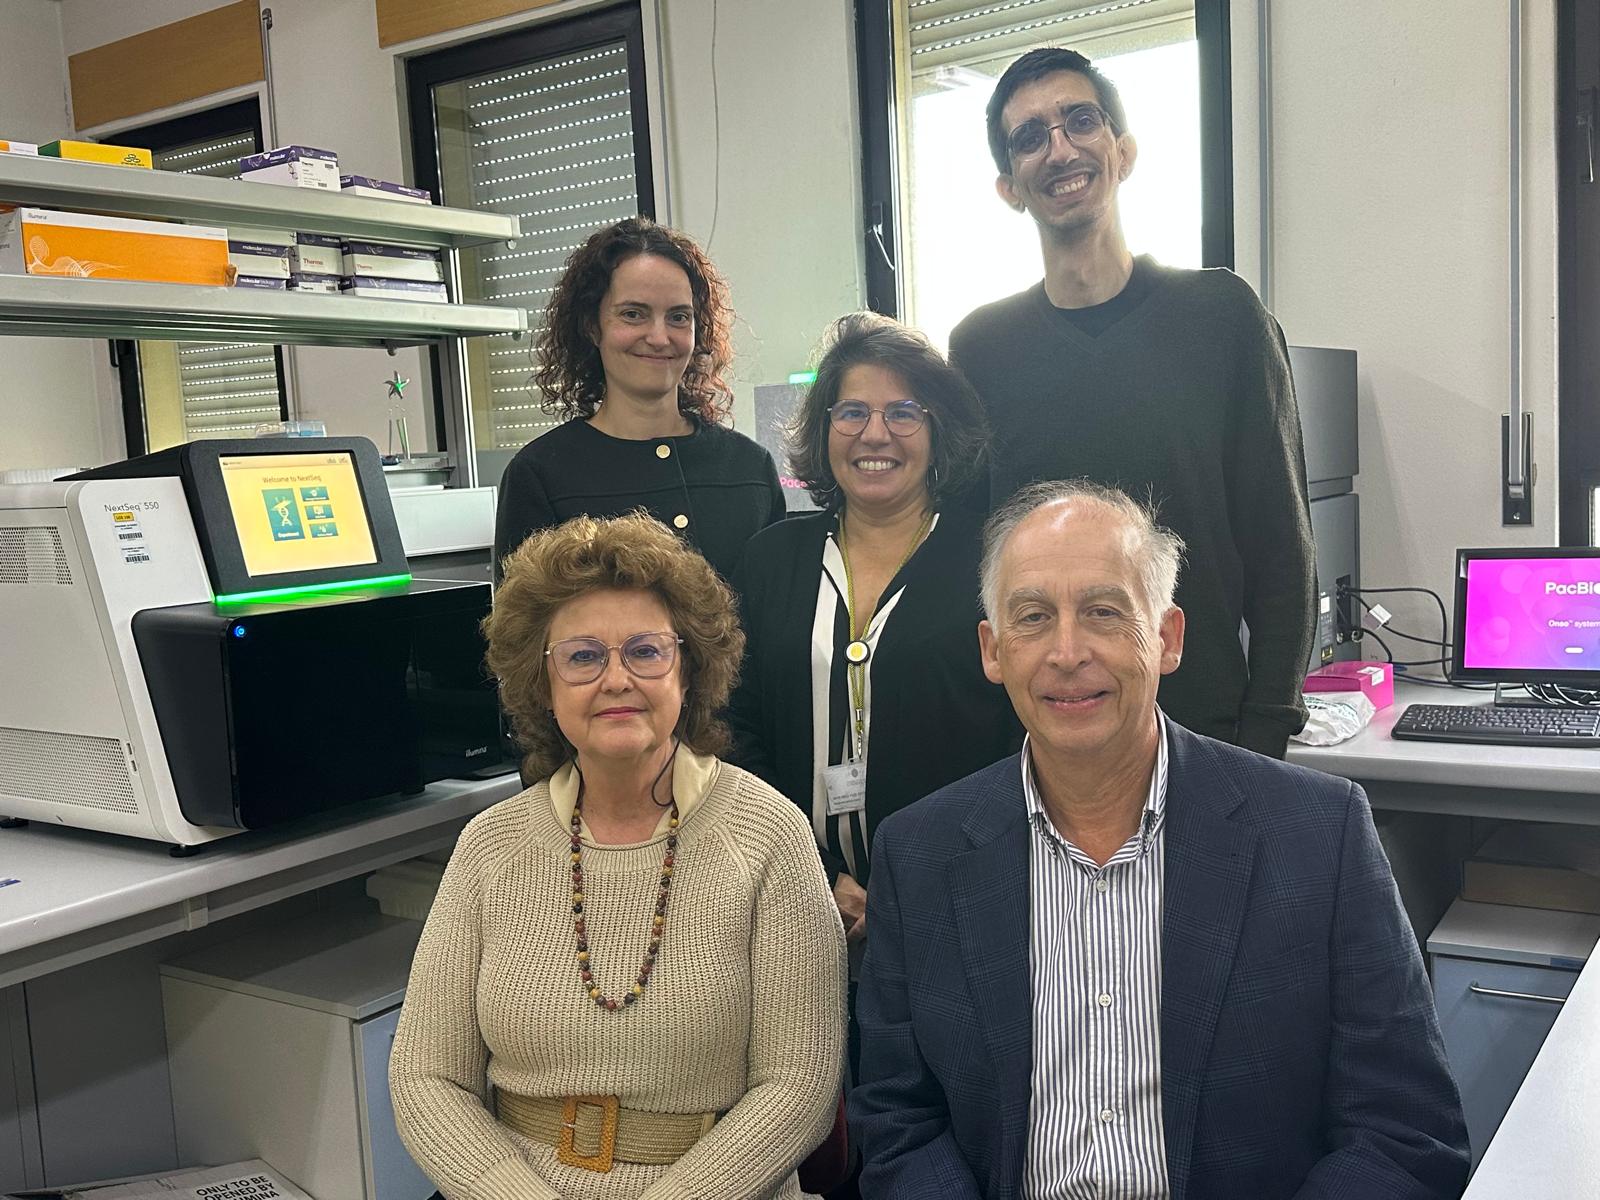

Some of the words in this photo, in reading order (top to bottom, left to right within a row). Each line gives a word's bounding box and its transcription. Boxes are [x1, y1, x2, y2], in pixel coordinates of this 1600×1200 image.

[104, 503, 141, 512] NextSeq
[143, 501, 160, 511] 550
[196, 1184, 230, 1196] ONLY
[231, 1180, 250, 1188] TO
[251, 1176, 269, 1184] BE
[204, 1186, 257, 1200] OPENED
[258, 1183, 275, 1191] BY
